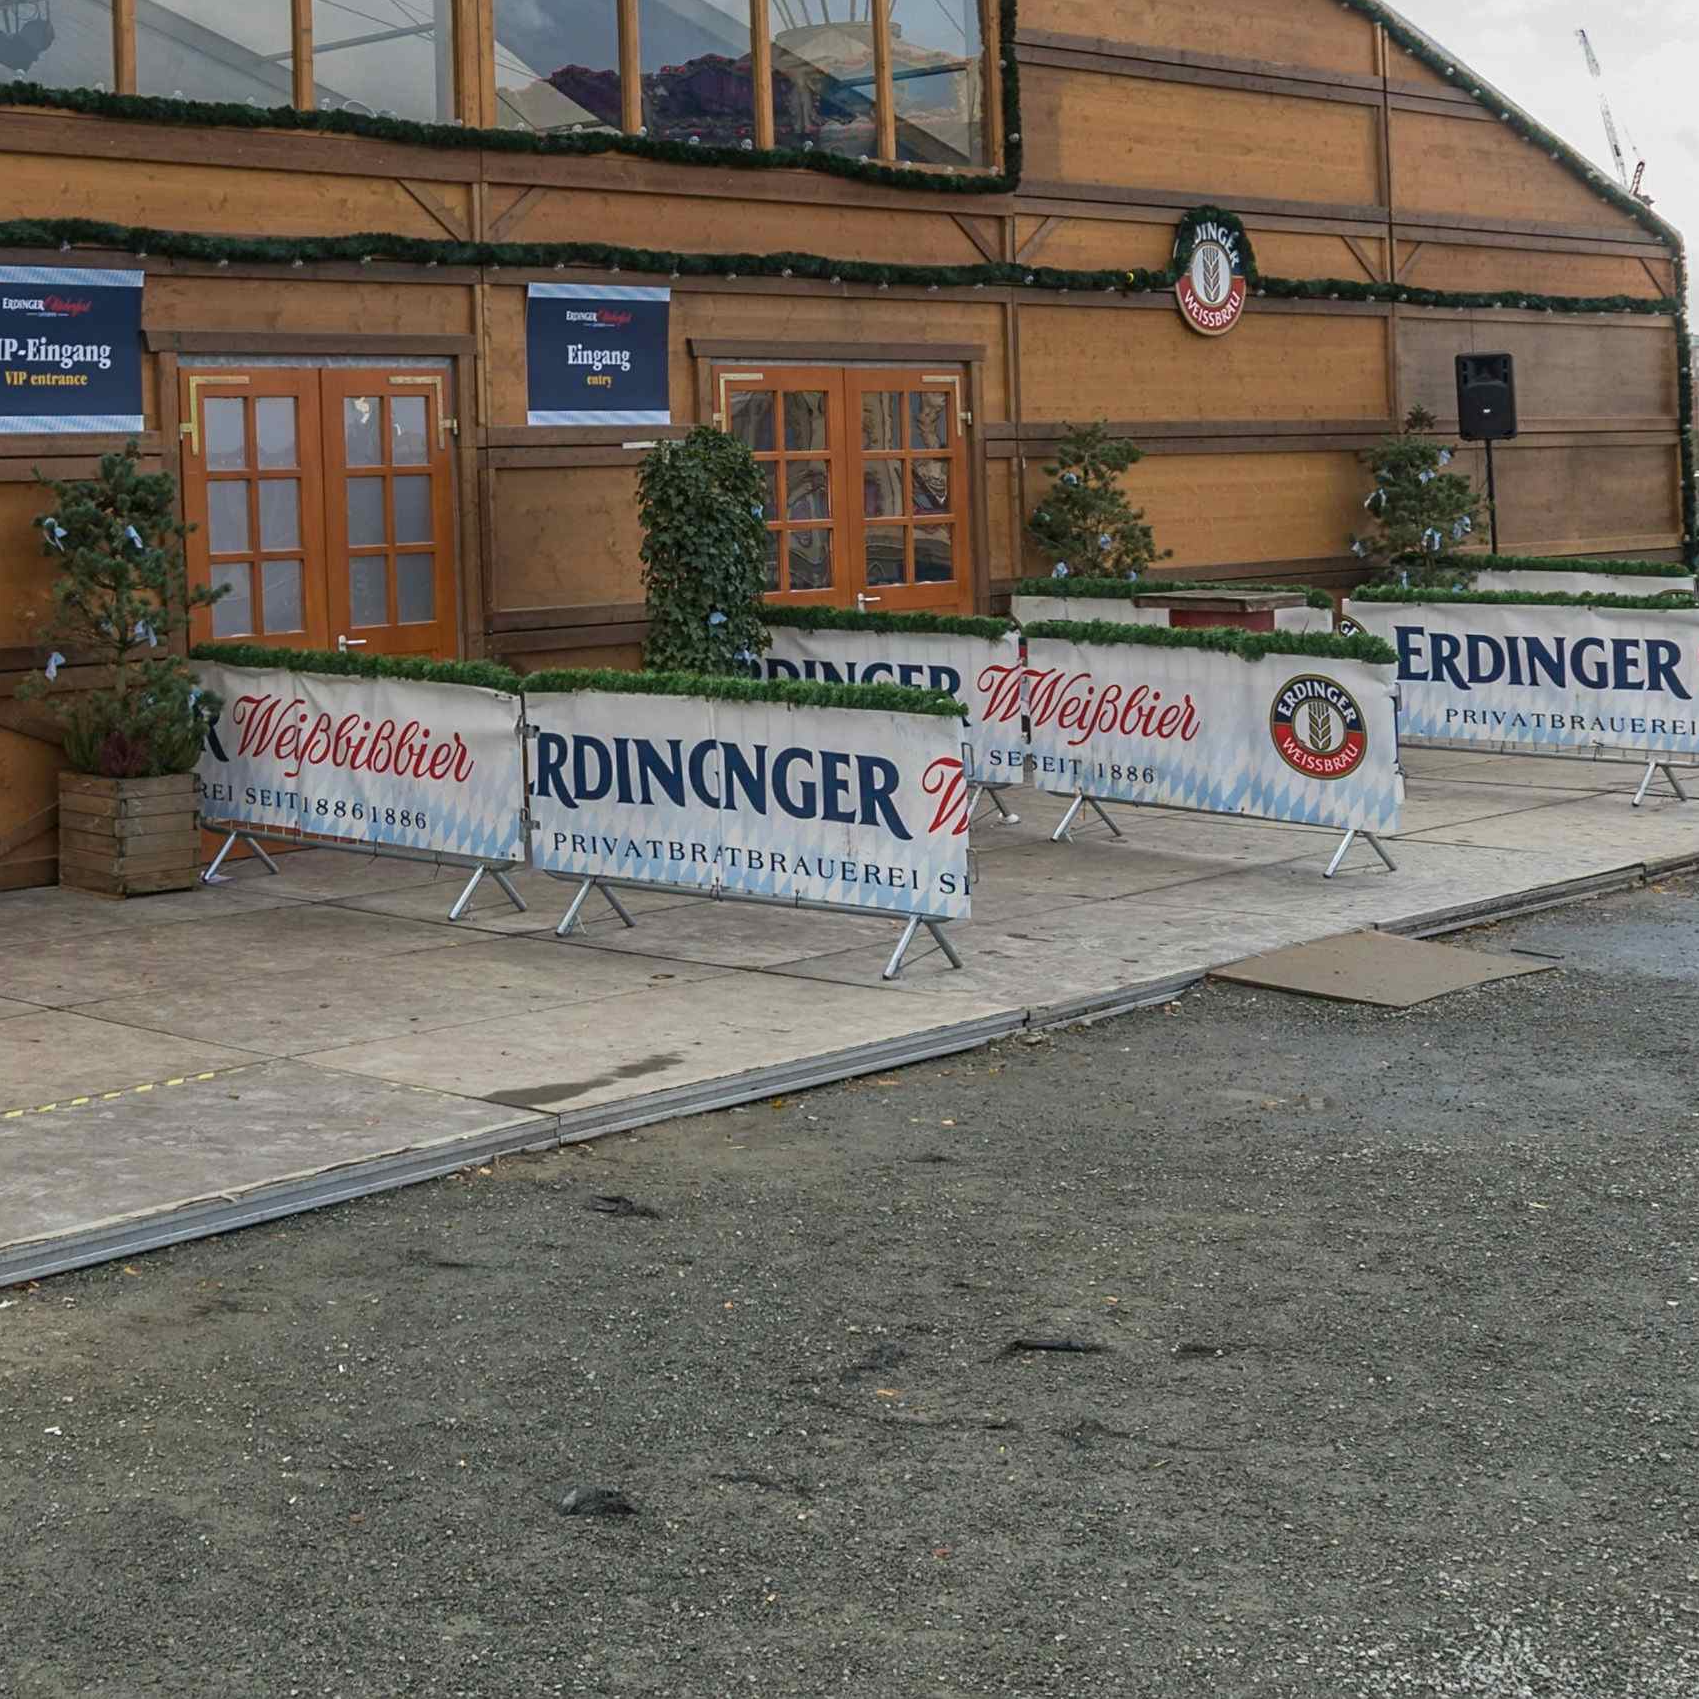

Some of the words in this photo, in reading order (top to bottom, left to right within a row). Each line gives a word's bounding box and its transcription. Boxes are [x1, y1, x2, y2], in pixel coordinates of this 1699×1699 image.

[567, 344, 631, 371] Eingang
[5, 371, 27, 386] VIP
[30, 374, 88, 386] entrance
[587, 374, 613, 388] entry
[1395, 626, 1693, 700] ERDINGER
[1278, 681, 1357, 723] ERDINGER
[1446, 708, 1696, 736] PRIVATBRAUEREI
[1098, 762, 1155, 784] 1886
